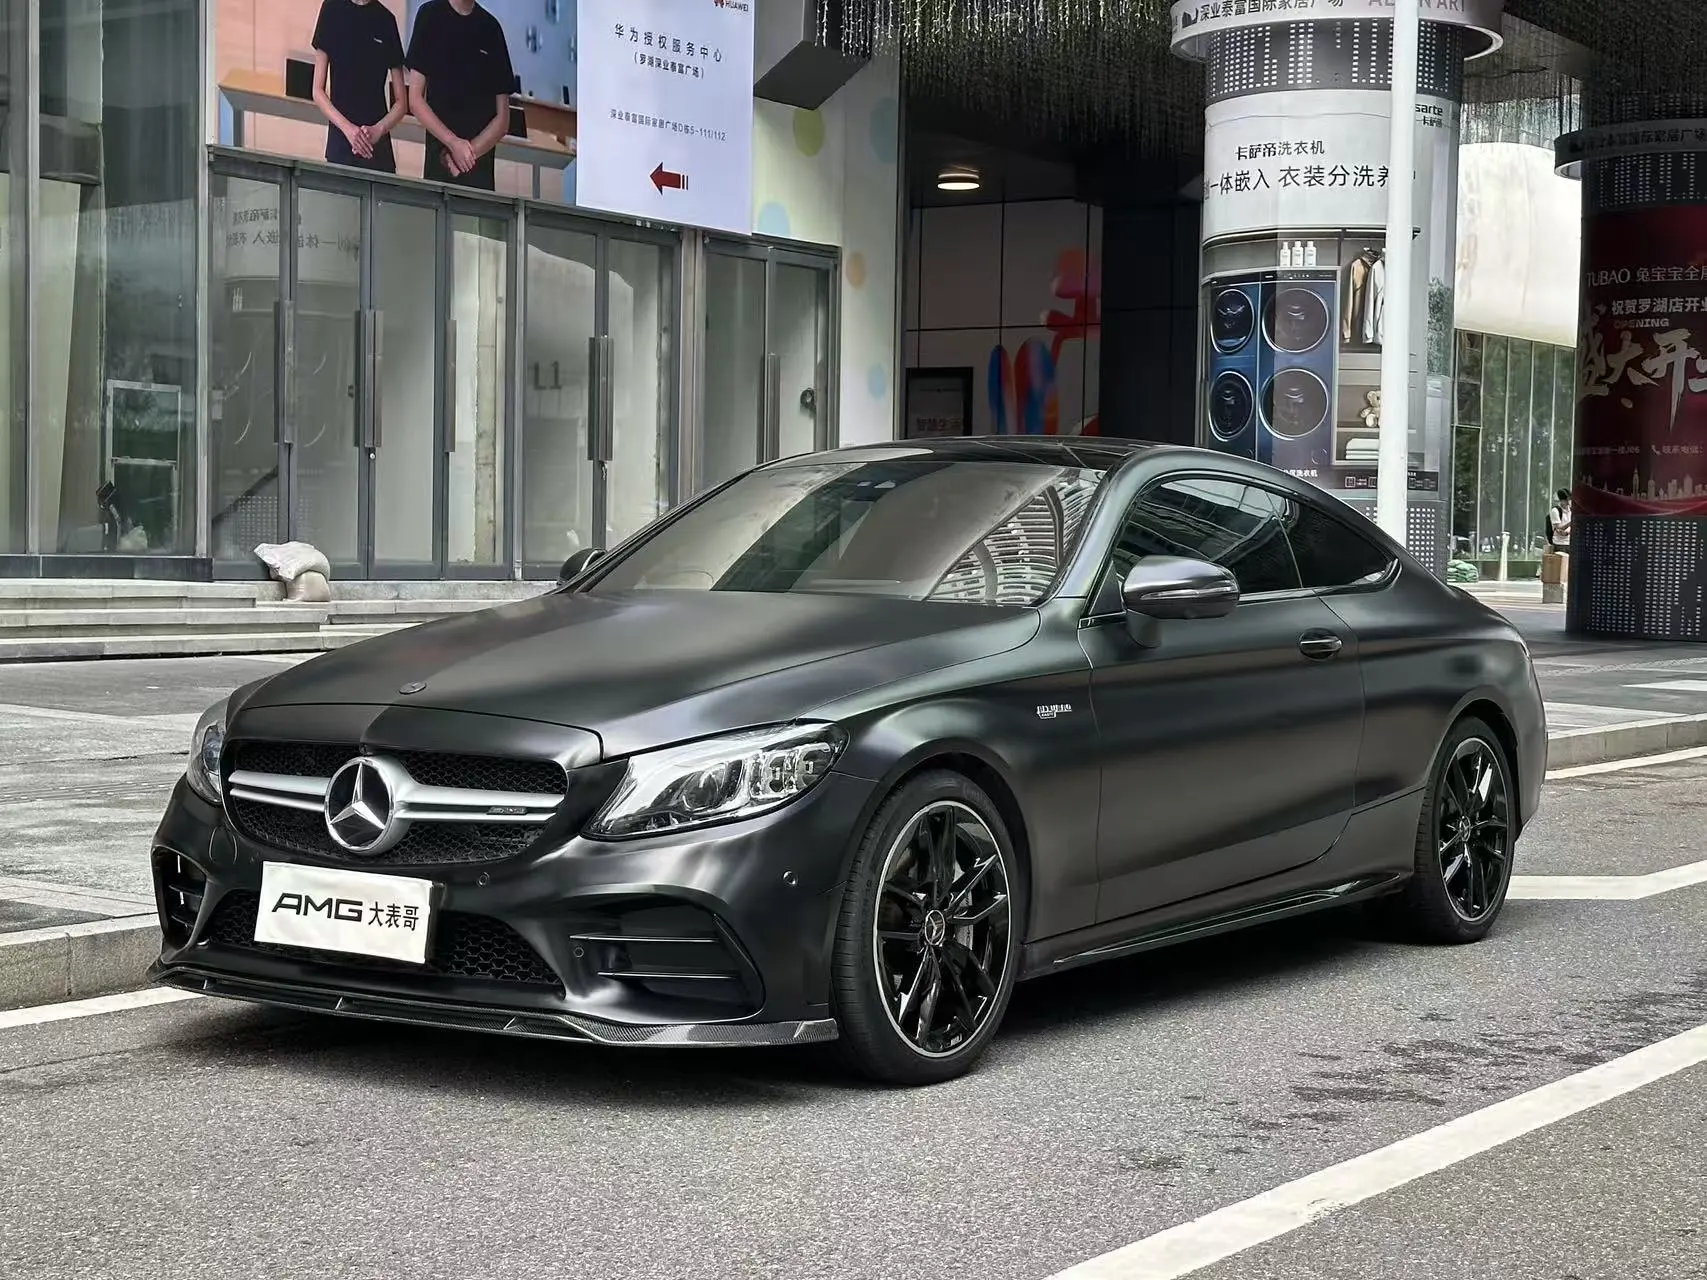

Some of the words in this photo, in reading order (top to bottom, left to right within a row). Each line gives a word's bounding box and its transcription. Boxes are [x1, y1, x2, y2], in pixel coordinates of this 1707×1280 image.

[614, 23, 722, 62] 华为授权服务中心
[1415, 103, 1443, 116] sarte
[1235, 139, 1325, 160] 卡萨帝洗衣机
[1206, 167, 1270, 196] 一体嵌入
[1585, 268, 1631, 288] TUBAO
[1613, 318, 1671, 329] OPENING
[271, 892, 364, 922] AMG
[367, 901, 420, 932] 大表哥
